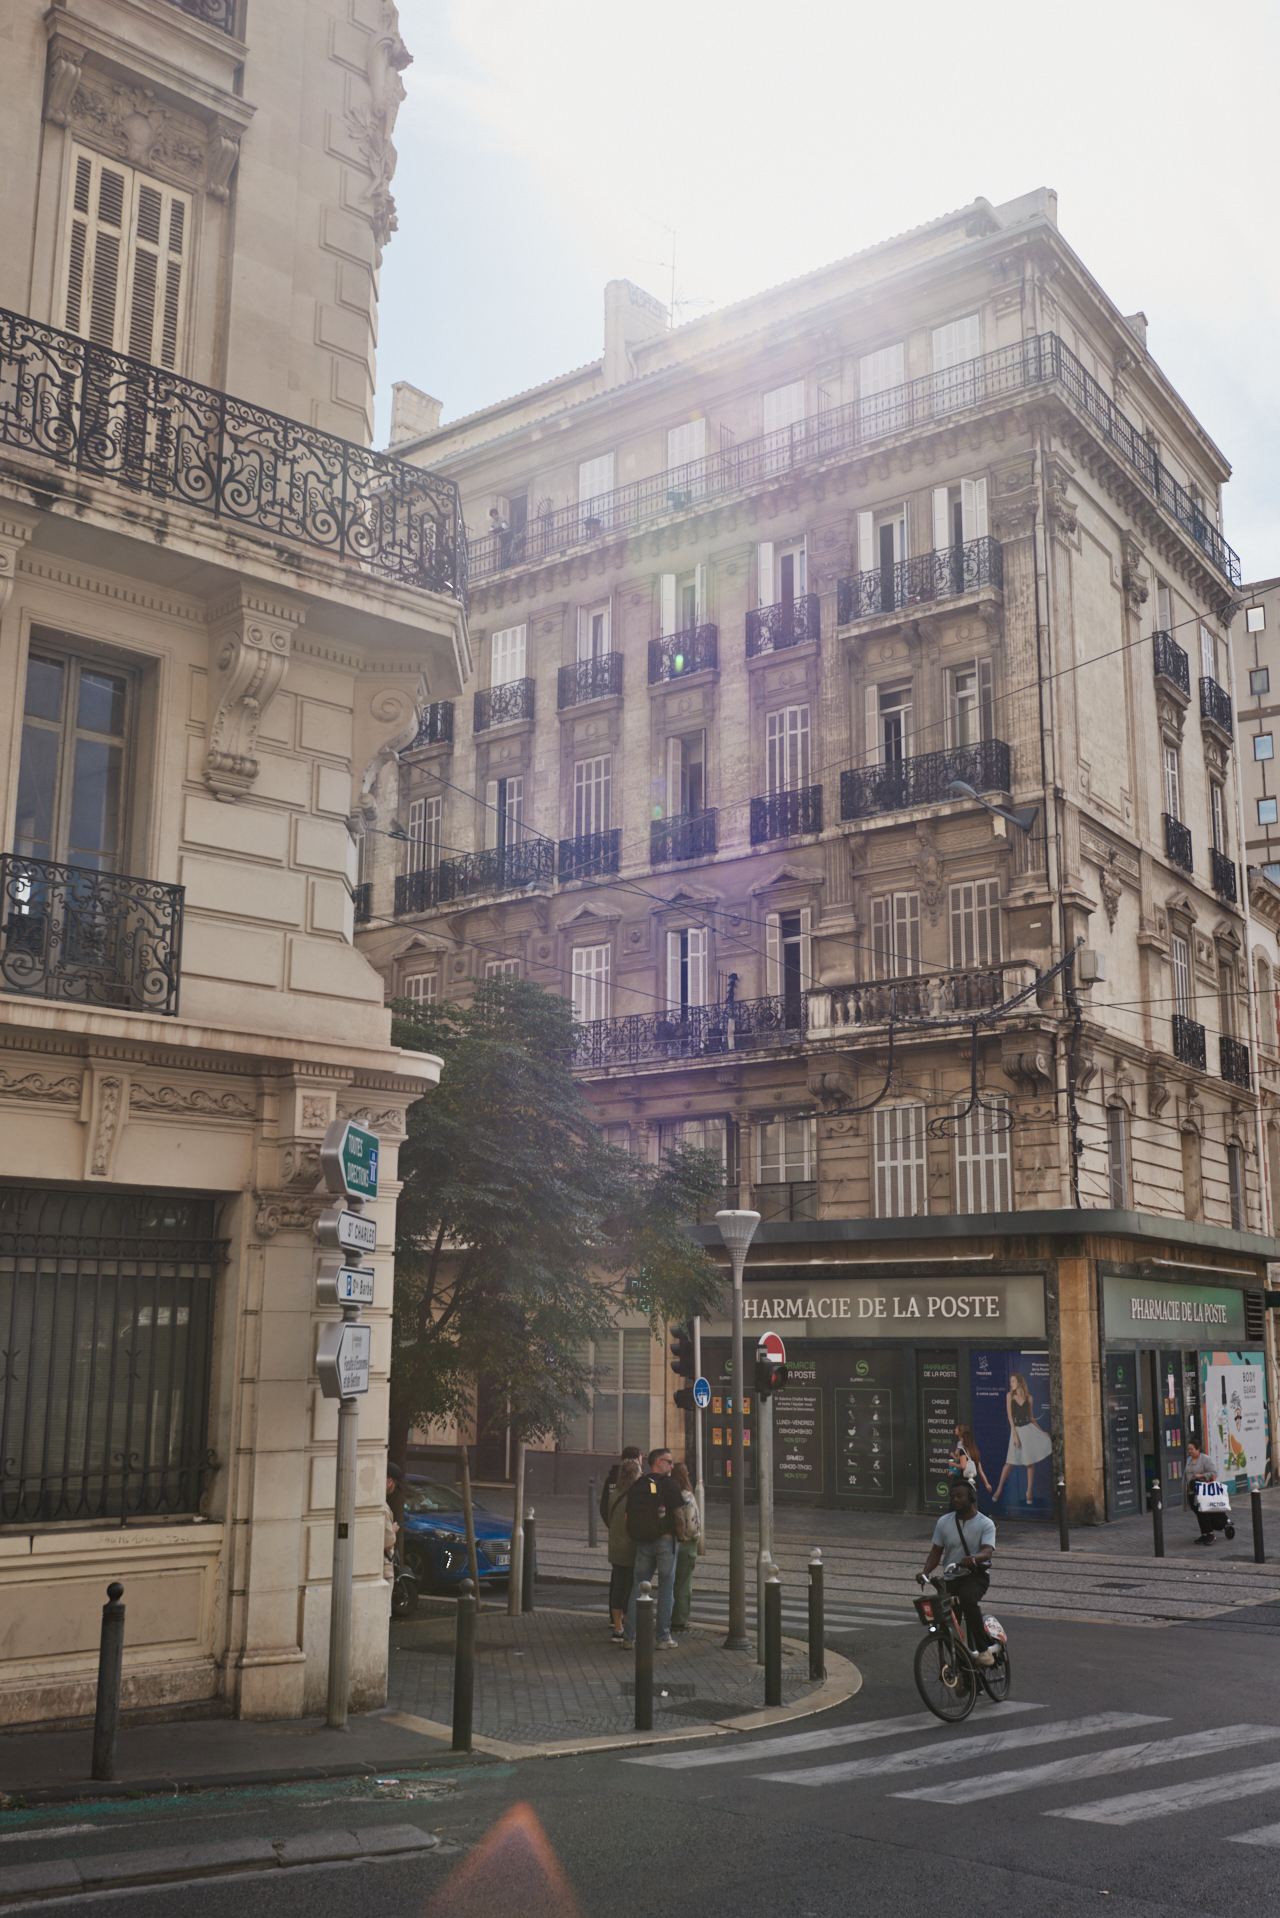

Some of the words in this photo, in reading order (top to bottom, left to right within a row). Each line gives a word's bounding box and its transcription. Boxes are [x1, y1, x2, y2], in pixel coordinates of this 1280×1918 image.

[348, 1133, 363, 1158] TOUTES
[347, 1161, 369, 1188] DIRECTIONS
[355, 1224, 375, 1244] CHARLES
[359, 1279, 373, 1296] Barbe
[741, 1297, 851, 1319] HARMACIE
[858, 1297, 887, 1318] DE
[893, 1297, 921, 1318] LA
[927, 1296, 1000, 1318] POSTE
[1131, 1298, 1180, 1321] PHARMACIE
[1181, 1301, 1192, 1322] DE
[1193, 1302, 1204, 1322] LA
[1204, 1303, 1227, 1324] POSTE
[785, 1361, 816, 1370] ARMACIE
[787, 1371, 793, 1379] A
[794, 1371, 816, 1379] POSTE
[1242, 1372, 1255, 1382] BODY
[1243, 1385, 1256, 1394] GUARD
[1195, 1482, 1224, 1496] TION
